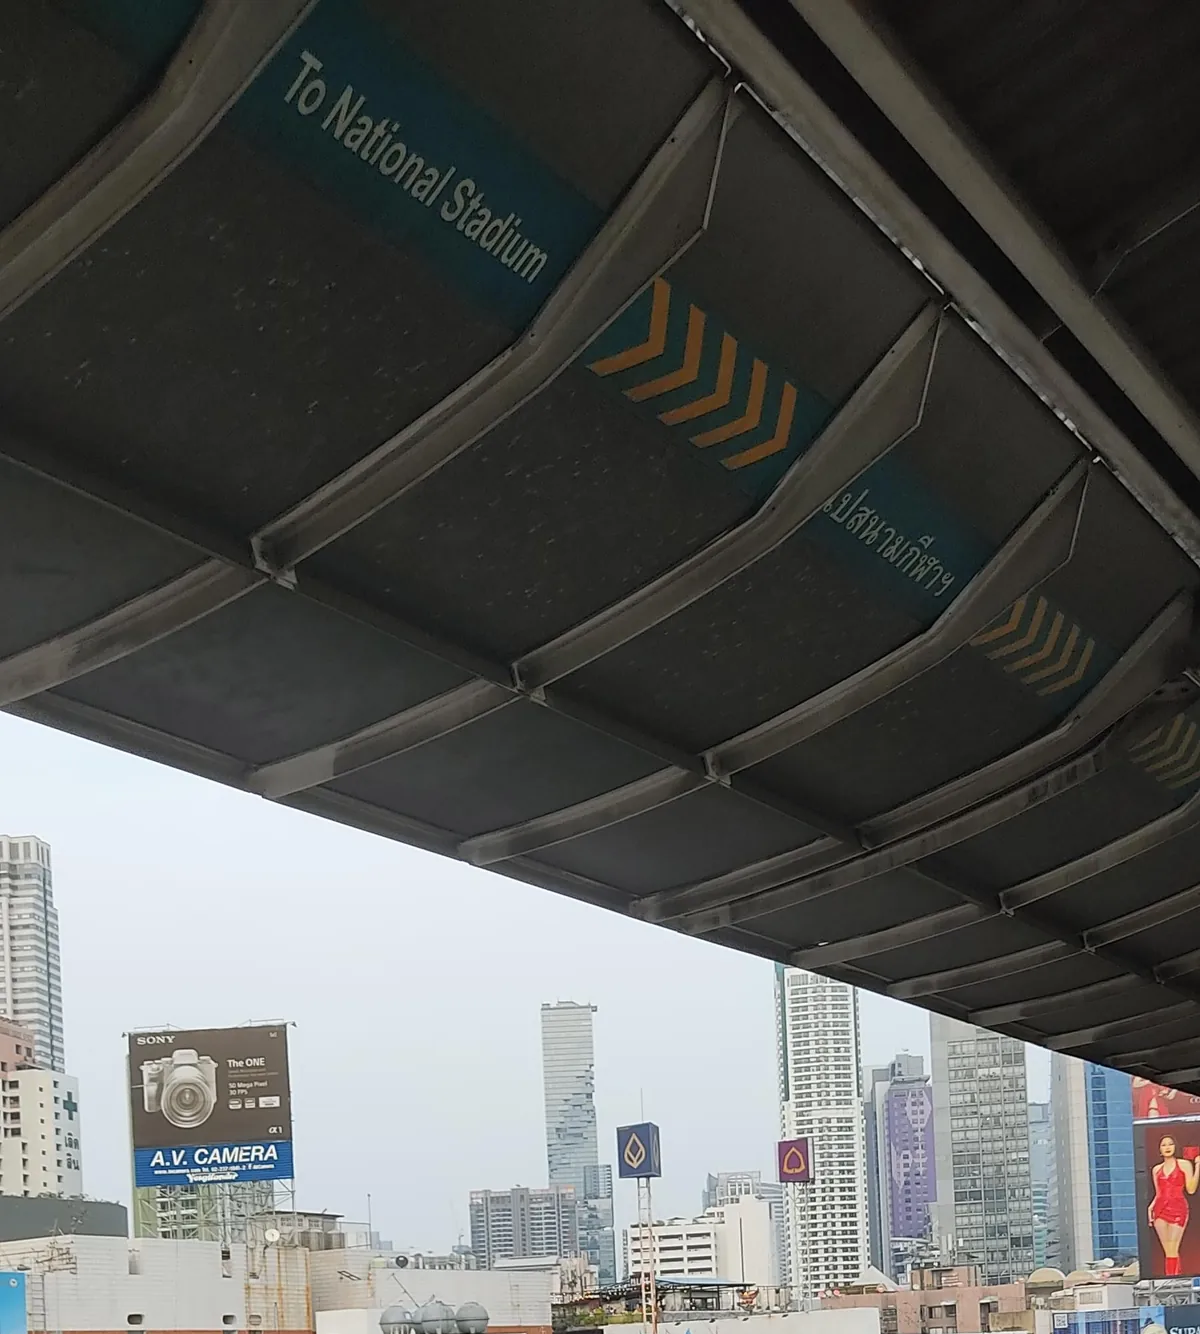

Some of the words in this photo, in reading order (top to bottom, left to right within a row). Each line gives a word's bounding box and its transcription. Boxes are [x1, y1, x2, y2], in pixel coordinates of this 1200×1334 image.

[284, 50, 327, 116] To
[321, 85, 457, 207] National
[440, 178, 549, 283] Stadium
[137, 1035, 175, 1045] SONY
[227, 1059, 244, 1068] The
[245, 1058, 265, 1067] ONE
[150, 1150, 188, 1167] A.V.
[194, 1144, 278, 1165] CAMERA
